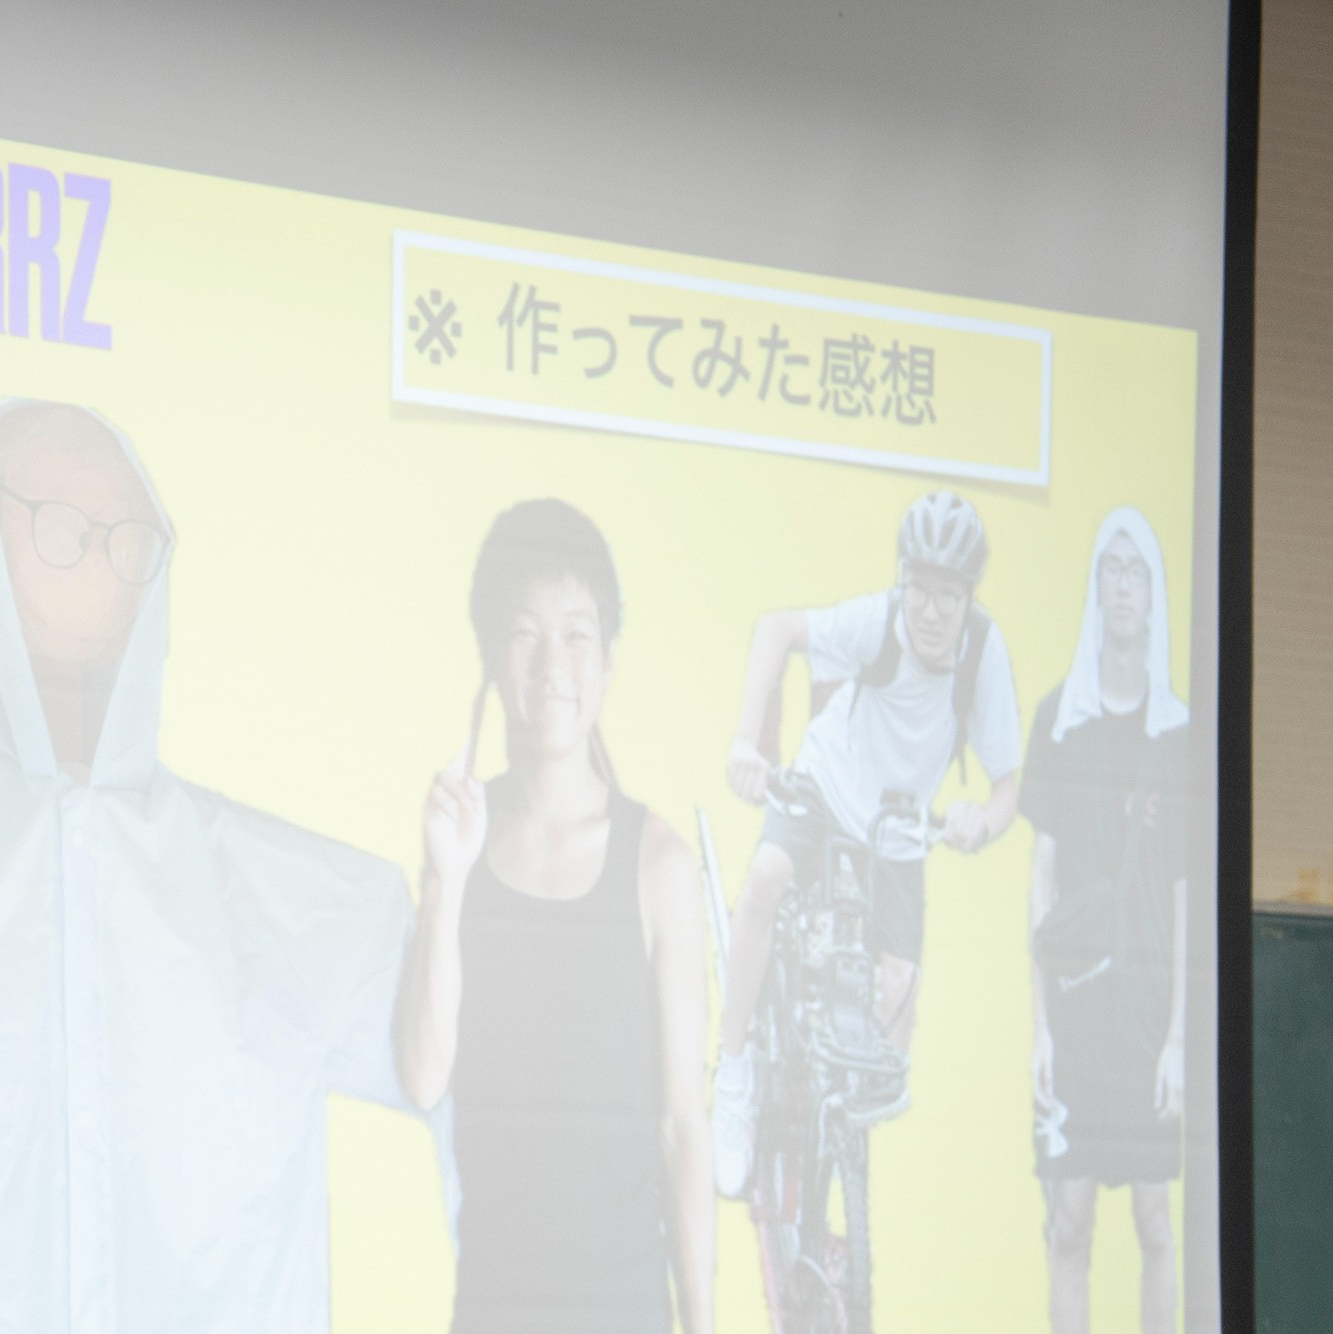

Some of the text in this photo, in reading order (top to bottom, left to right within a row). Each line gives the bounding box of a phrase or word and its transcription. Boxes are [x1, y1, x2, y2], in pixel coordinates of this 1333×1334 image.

[496, 281, 938, 427] 作ってみた感想
